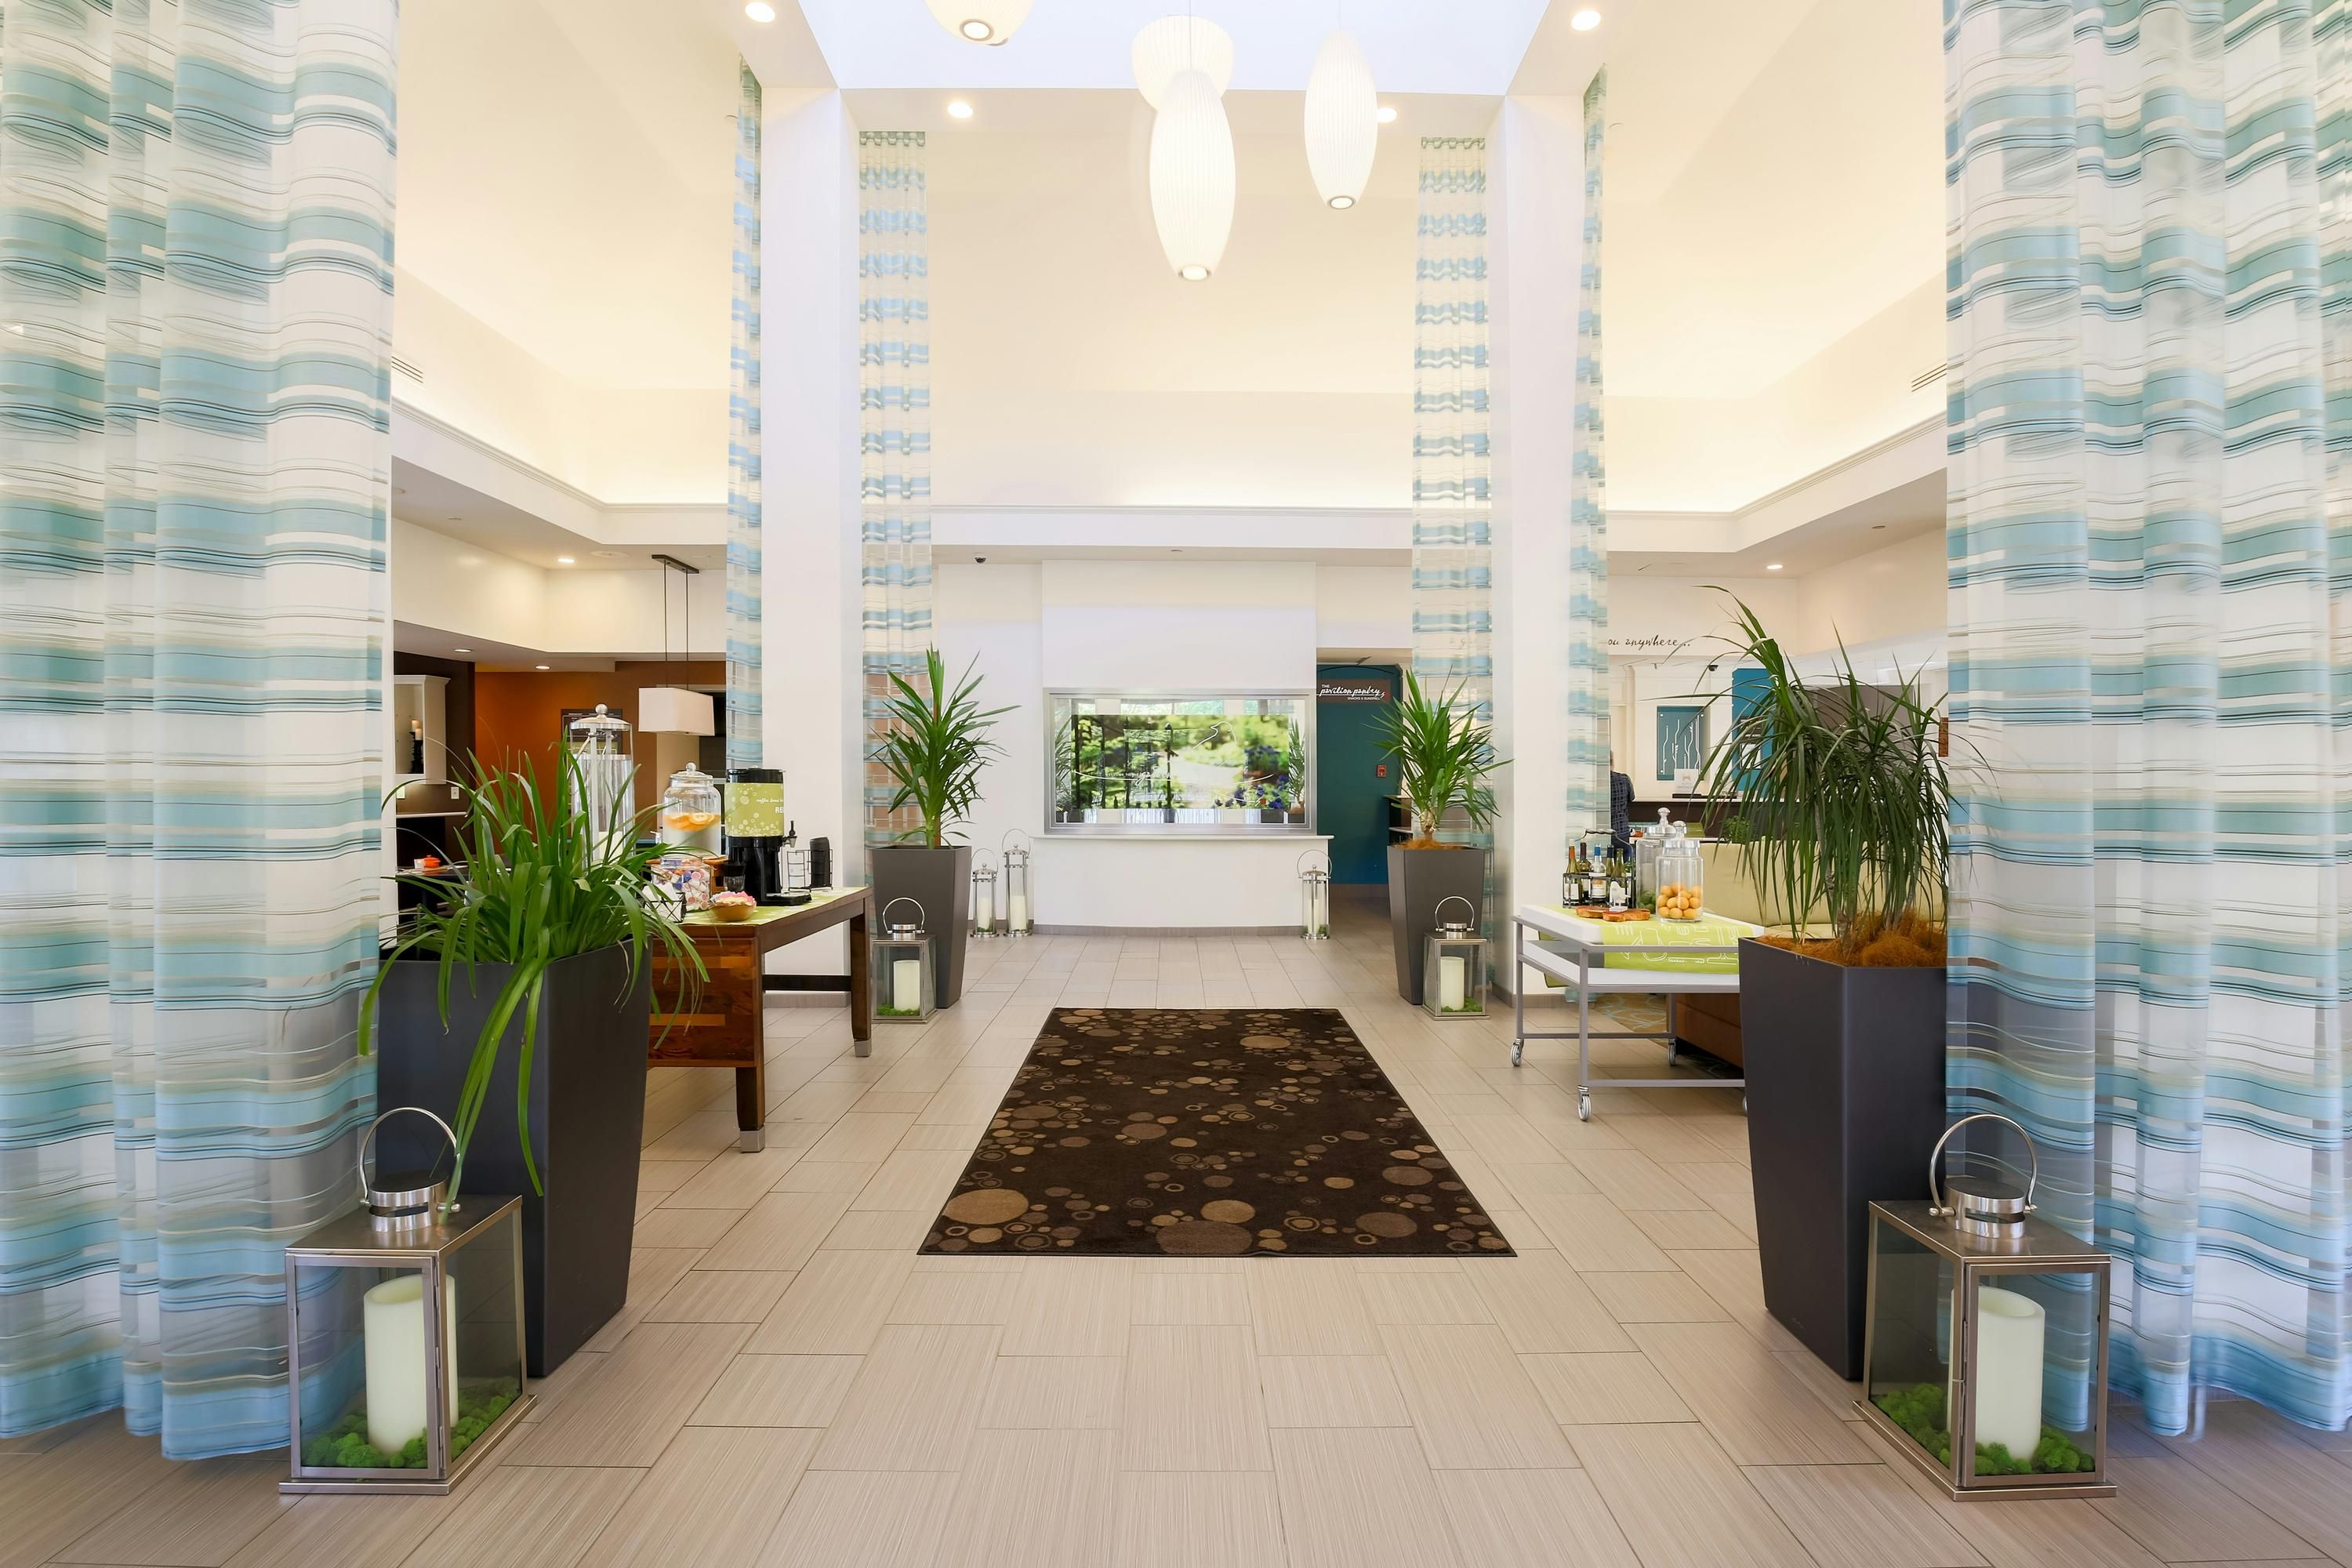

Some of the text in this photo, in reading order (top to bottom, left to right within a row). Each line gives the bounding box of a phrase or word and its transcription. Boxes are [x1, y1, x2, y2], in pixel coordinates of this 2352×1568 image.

[1625, 634, 1691, 651] anywhere..
[1319, 685, 1380, 698] pavilion pantry
